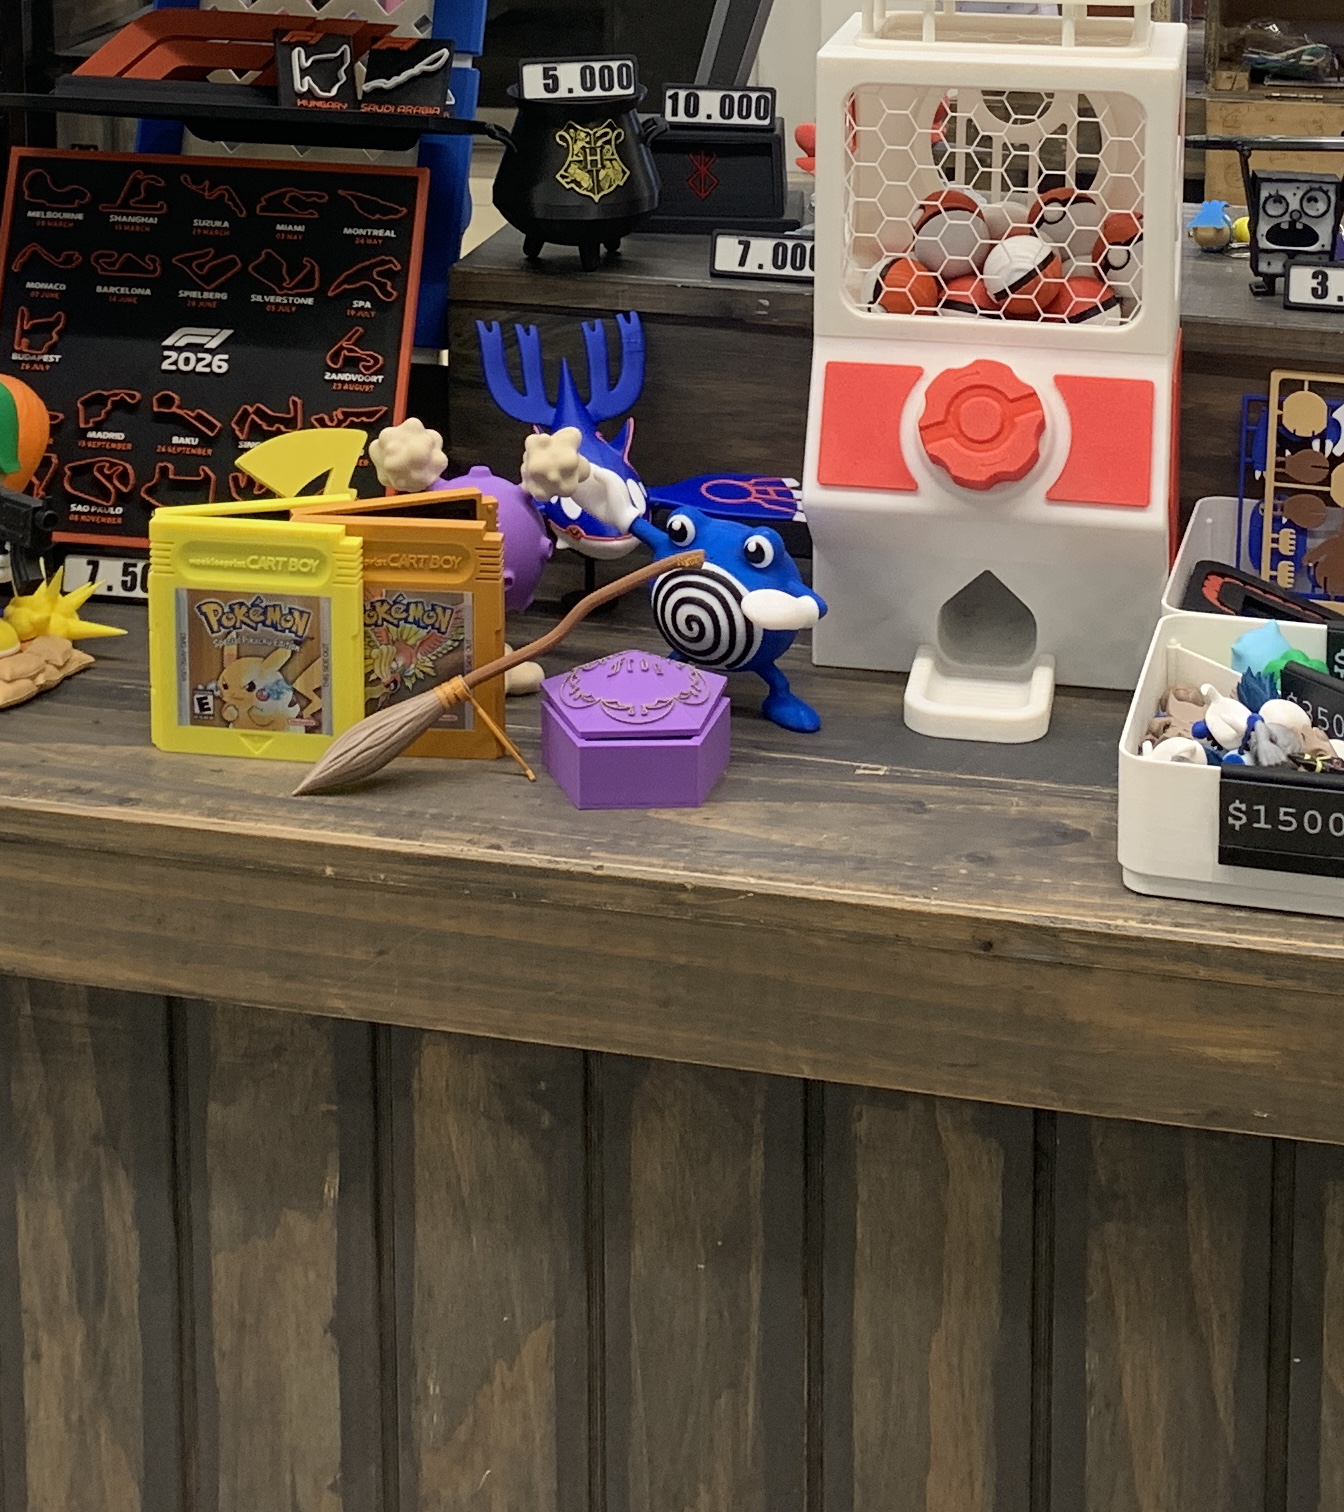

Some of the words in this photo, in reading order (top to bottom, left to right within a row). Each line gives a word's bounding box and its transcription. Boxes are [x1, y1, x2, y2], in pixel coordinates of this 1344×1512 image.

[542, 63, 633, 94] 5.000
[297, 99, 348, 110] HUNGARY
[360, 103, 396, 113] SAUDI
[397, 105, 441, 115] ARABIA
[668, 91, 770, 121] 10.000
[27, 210, 84, 220] MELBOURNE
[109, 214, 158, 224] SHANGHAI
[193, 219, 230, 228] SUZUKA
[276, 223, 305, 232] MIAMI
[343, 227, 396, 238] MONTREAL
[737, 240, 815, 272] 7.00
[26, 281, 67, 291] MONACO
[96, 285, 151, 295] BARCELONA
[178, 290, 227, 300] SPIELBERG
[250, 294, 315, 305] SILVERSTONE
[352, 300, 371, 308] SPA
[11, 352, 62, 363] BUDAPEST
[160, 351, 230, 374] 2026
[324, 371, 384, 383] ZANDVOORT
[87, 431, 126, 441] MADRID
[171, 436, 199, 445] BAKU
[70, 503, 90, 513] SAO
[91, 504, 124, 515] PAULO
[246, 555, 287, 571] CART
[288, 558, 320, 572] BOY
[388, 554, 429, 569] CART
[429, 555, 462, 569] BOY
[273, 639, 300, 652] Edition
